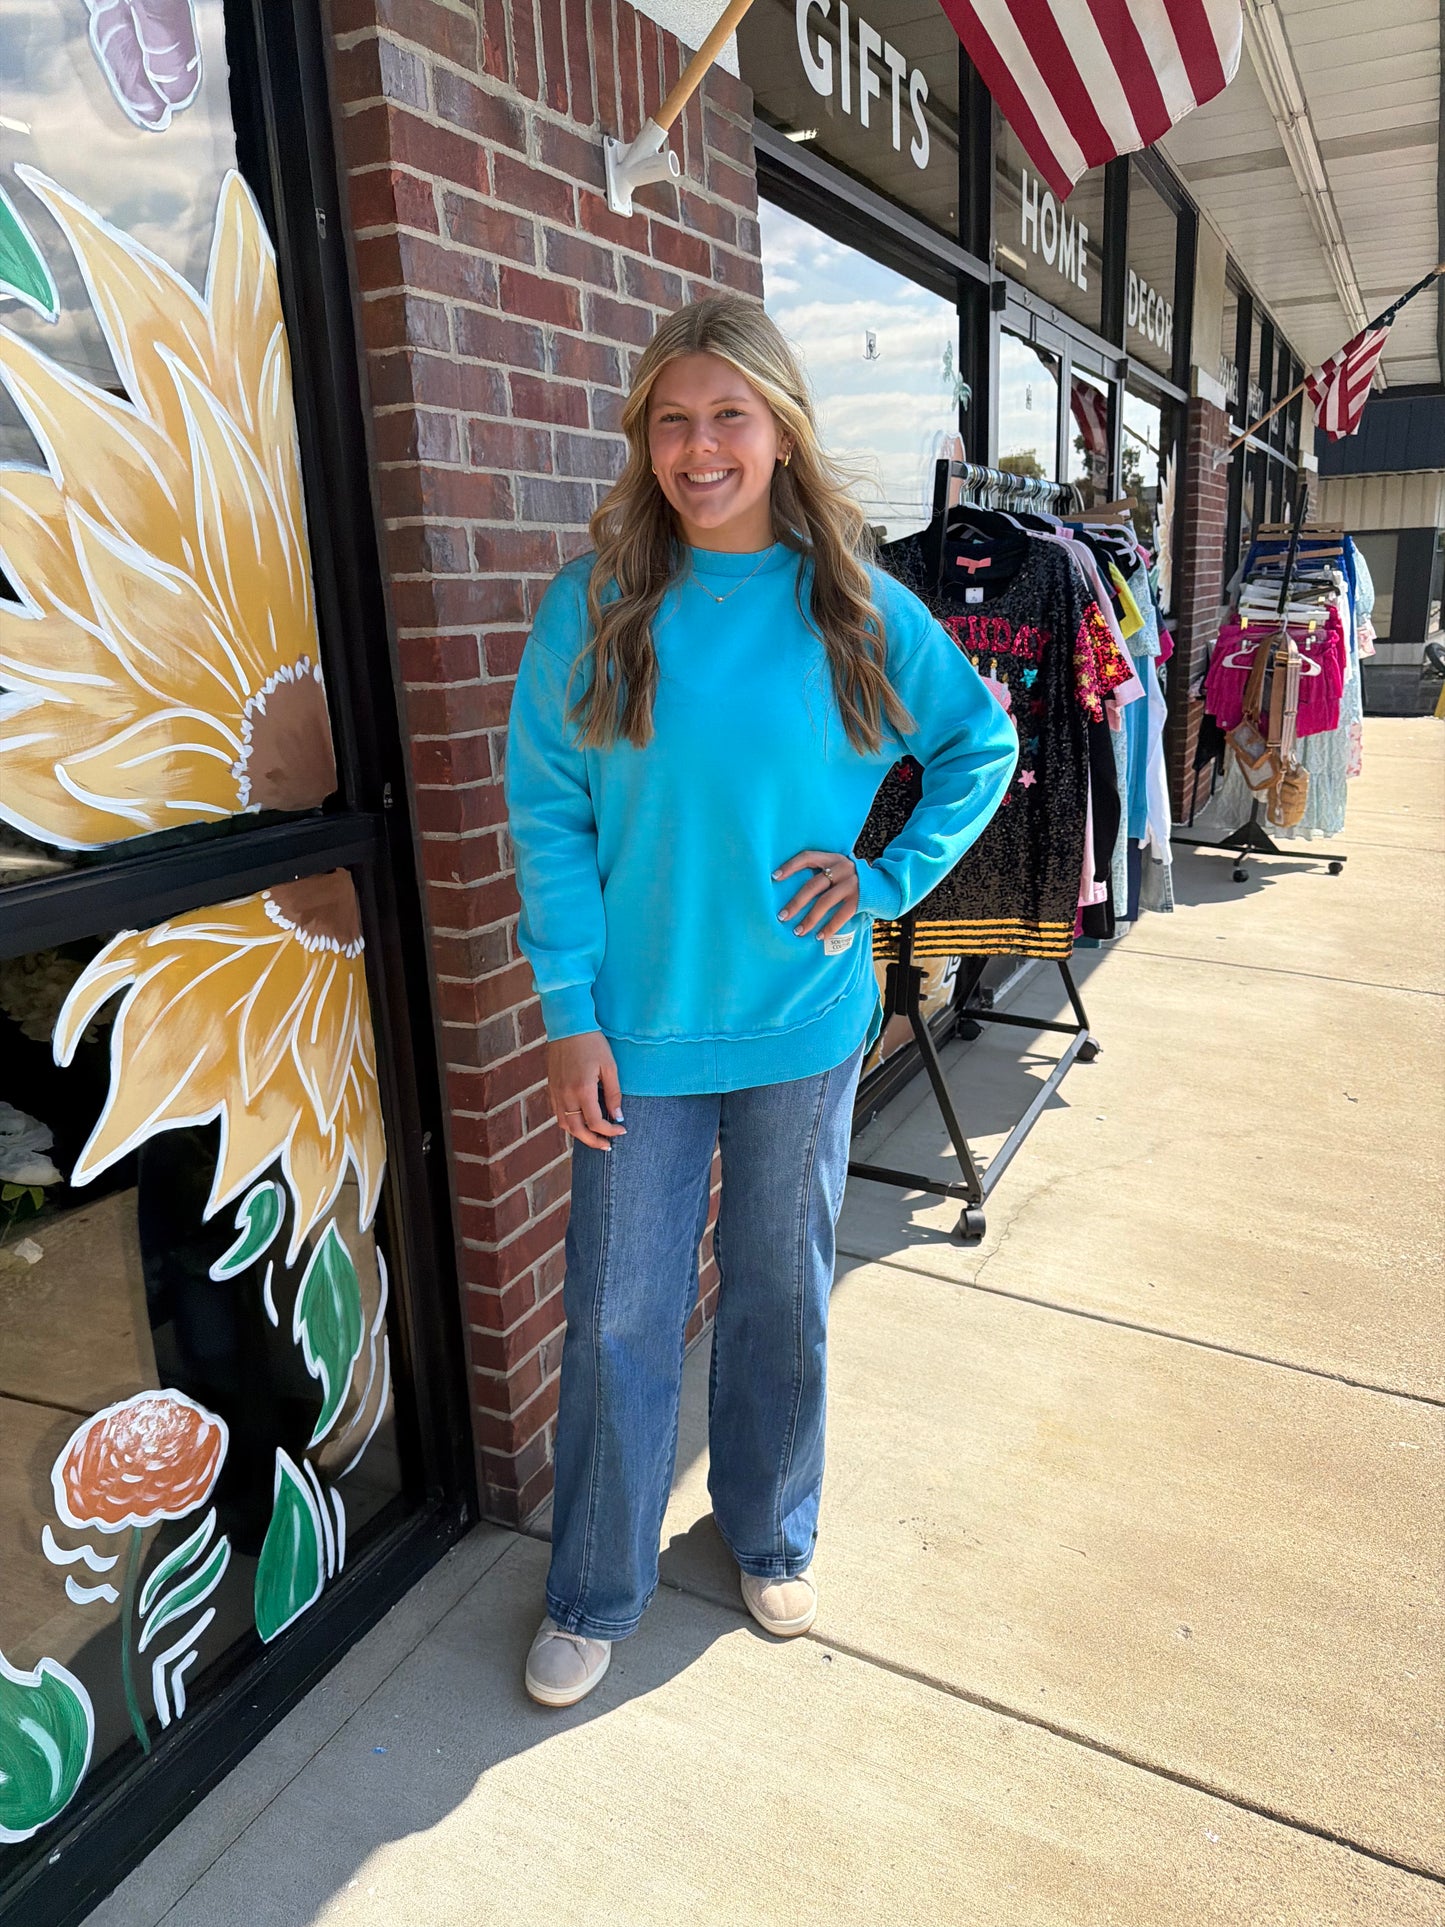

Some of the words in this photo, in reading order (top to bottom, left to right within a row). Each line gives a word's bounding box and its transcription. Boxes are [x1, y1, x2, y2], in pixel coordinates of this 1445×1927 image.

[796, 0, 930, 170] GIFTS
[1021, 168, 1089, 293] HOME
[1127, 268, 1174, 356] DECOR
[945, 615, 1052, 663] THDAY
